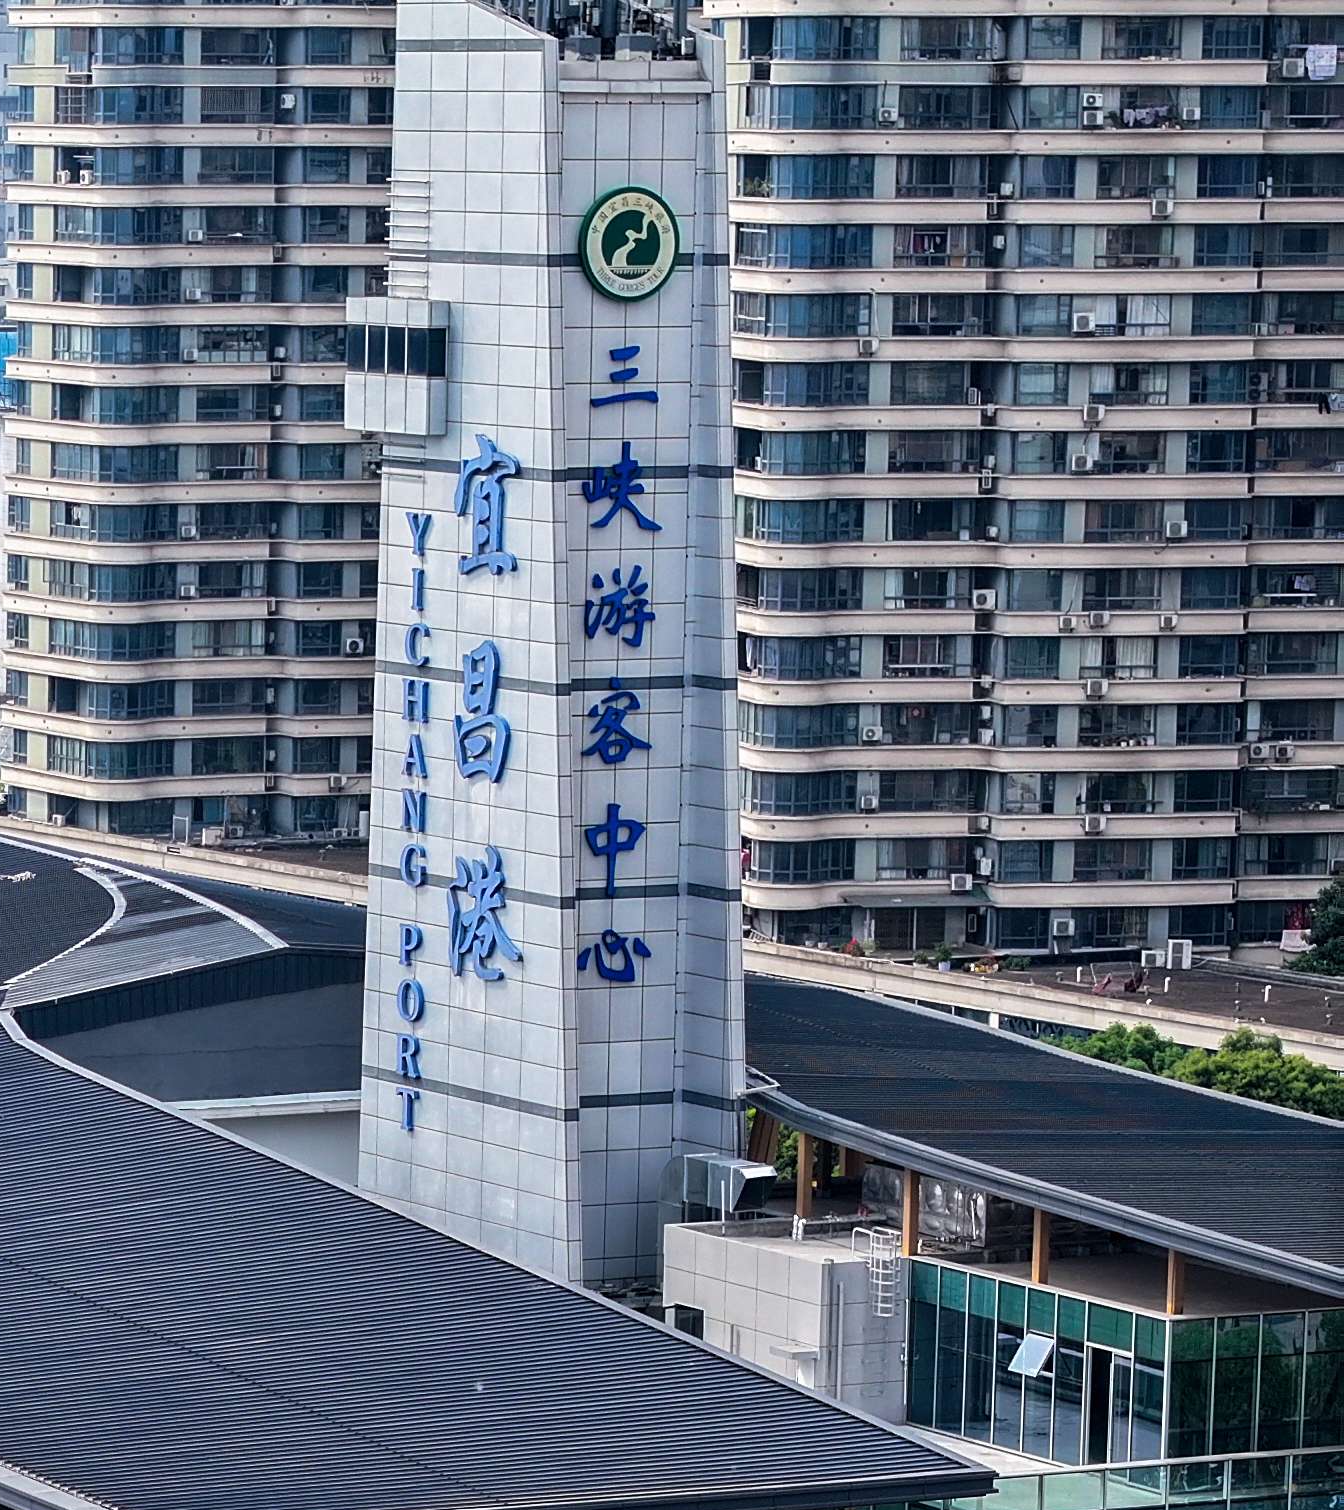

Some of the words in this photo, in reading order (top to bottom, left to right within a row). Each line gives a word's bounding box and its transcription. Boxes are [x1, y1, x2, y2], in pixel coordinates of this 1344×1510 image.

[400, 511, 432, 888] YICHANG
[447, 433, 524, 981] 宜昌港
[577, 344, 662, 982] 三峡游客中心
[396, 922, 424, 1132] PORT
